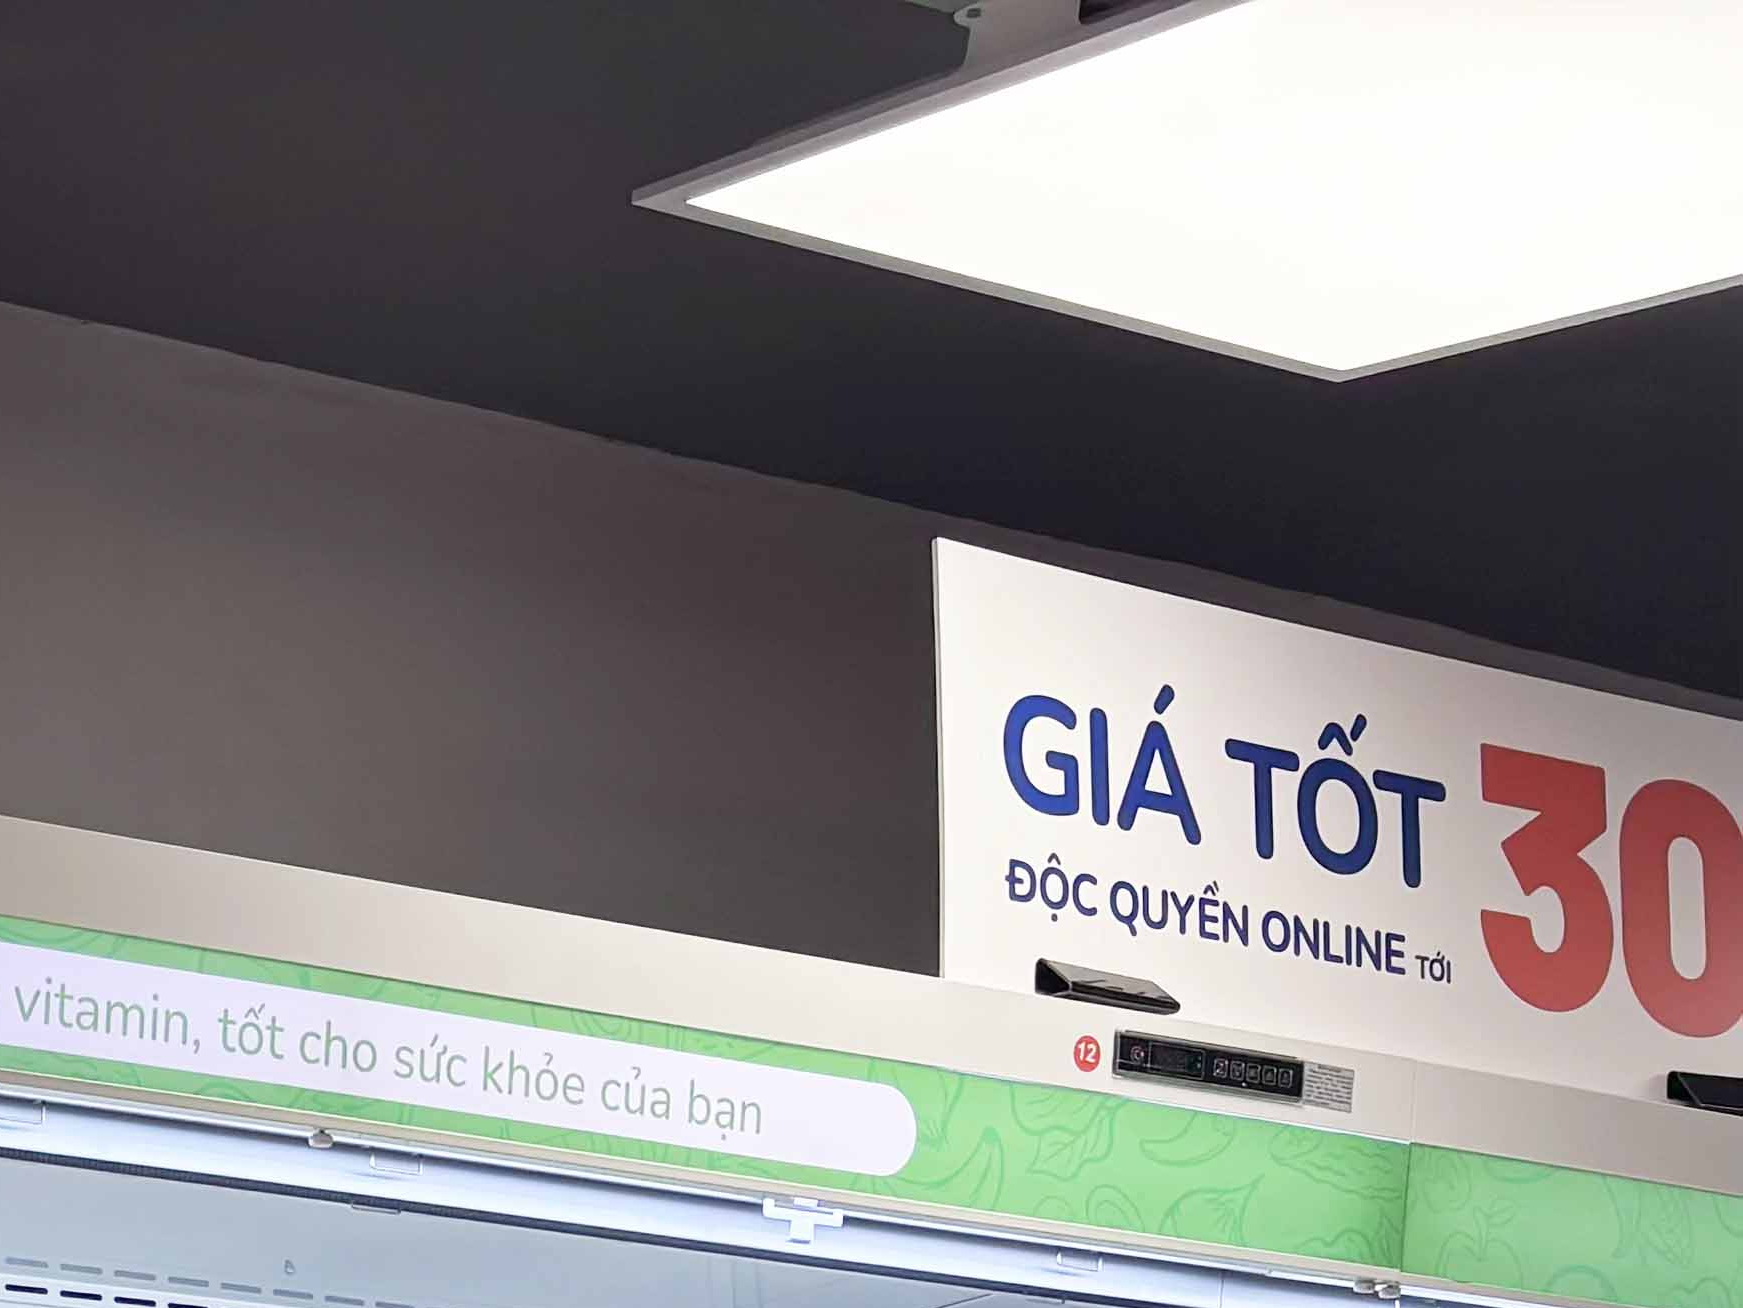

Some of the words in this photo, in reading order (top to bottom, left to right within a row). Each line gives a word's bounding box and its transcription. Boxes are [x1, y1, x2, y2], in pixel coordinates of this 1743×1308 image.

[1002, 684, 1202, 845] GIÁ
[1225, 713, 1446, 889] TỐT
[1005, 852, 1098, 925] ĐỘC
[1109, 880, 1249, 947] QUYỀN
[1262, 909, 1406, 976] ONLINE
[1415, 949, 1452, 985] TỚI
[14, 980, 201, 1051] vitamin,
[218, 1003, 286, 1061] tốt
[299, 1020, 378, 1074] cho
[395, 1033, 469, 1088] sức
[482, 1044, 585, 1107] khỏe
[602, 1066, 672, 1121] của
[688, 1081, 763, 1138] bạn
[1076, 1042, 1099, 1064] 12
